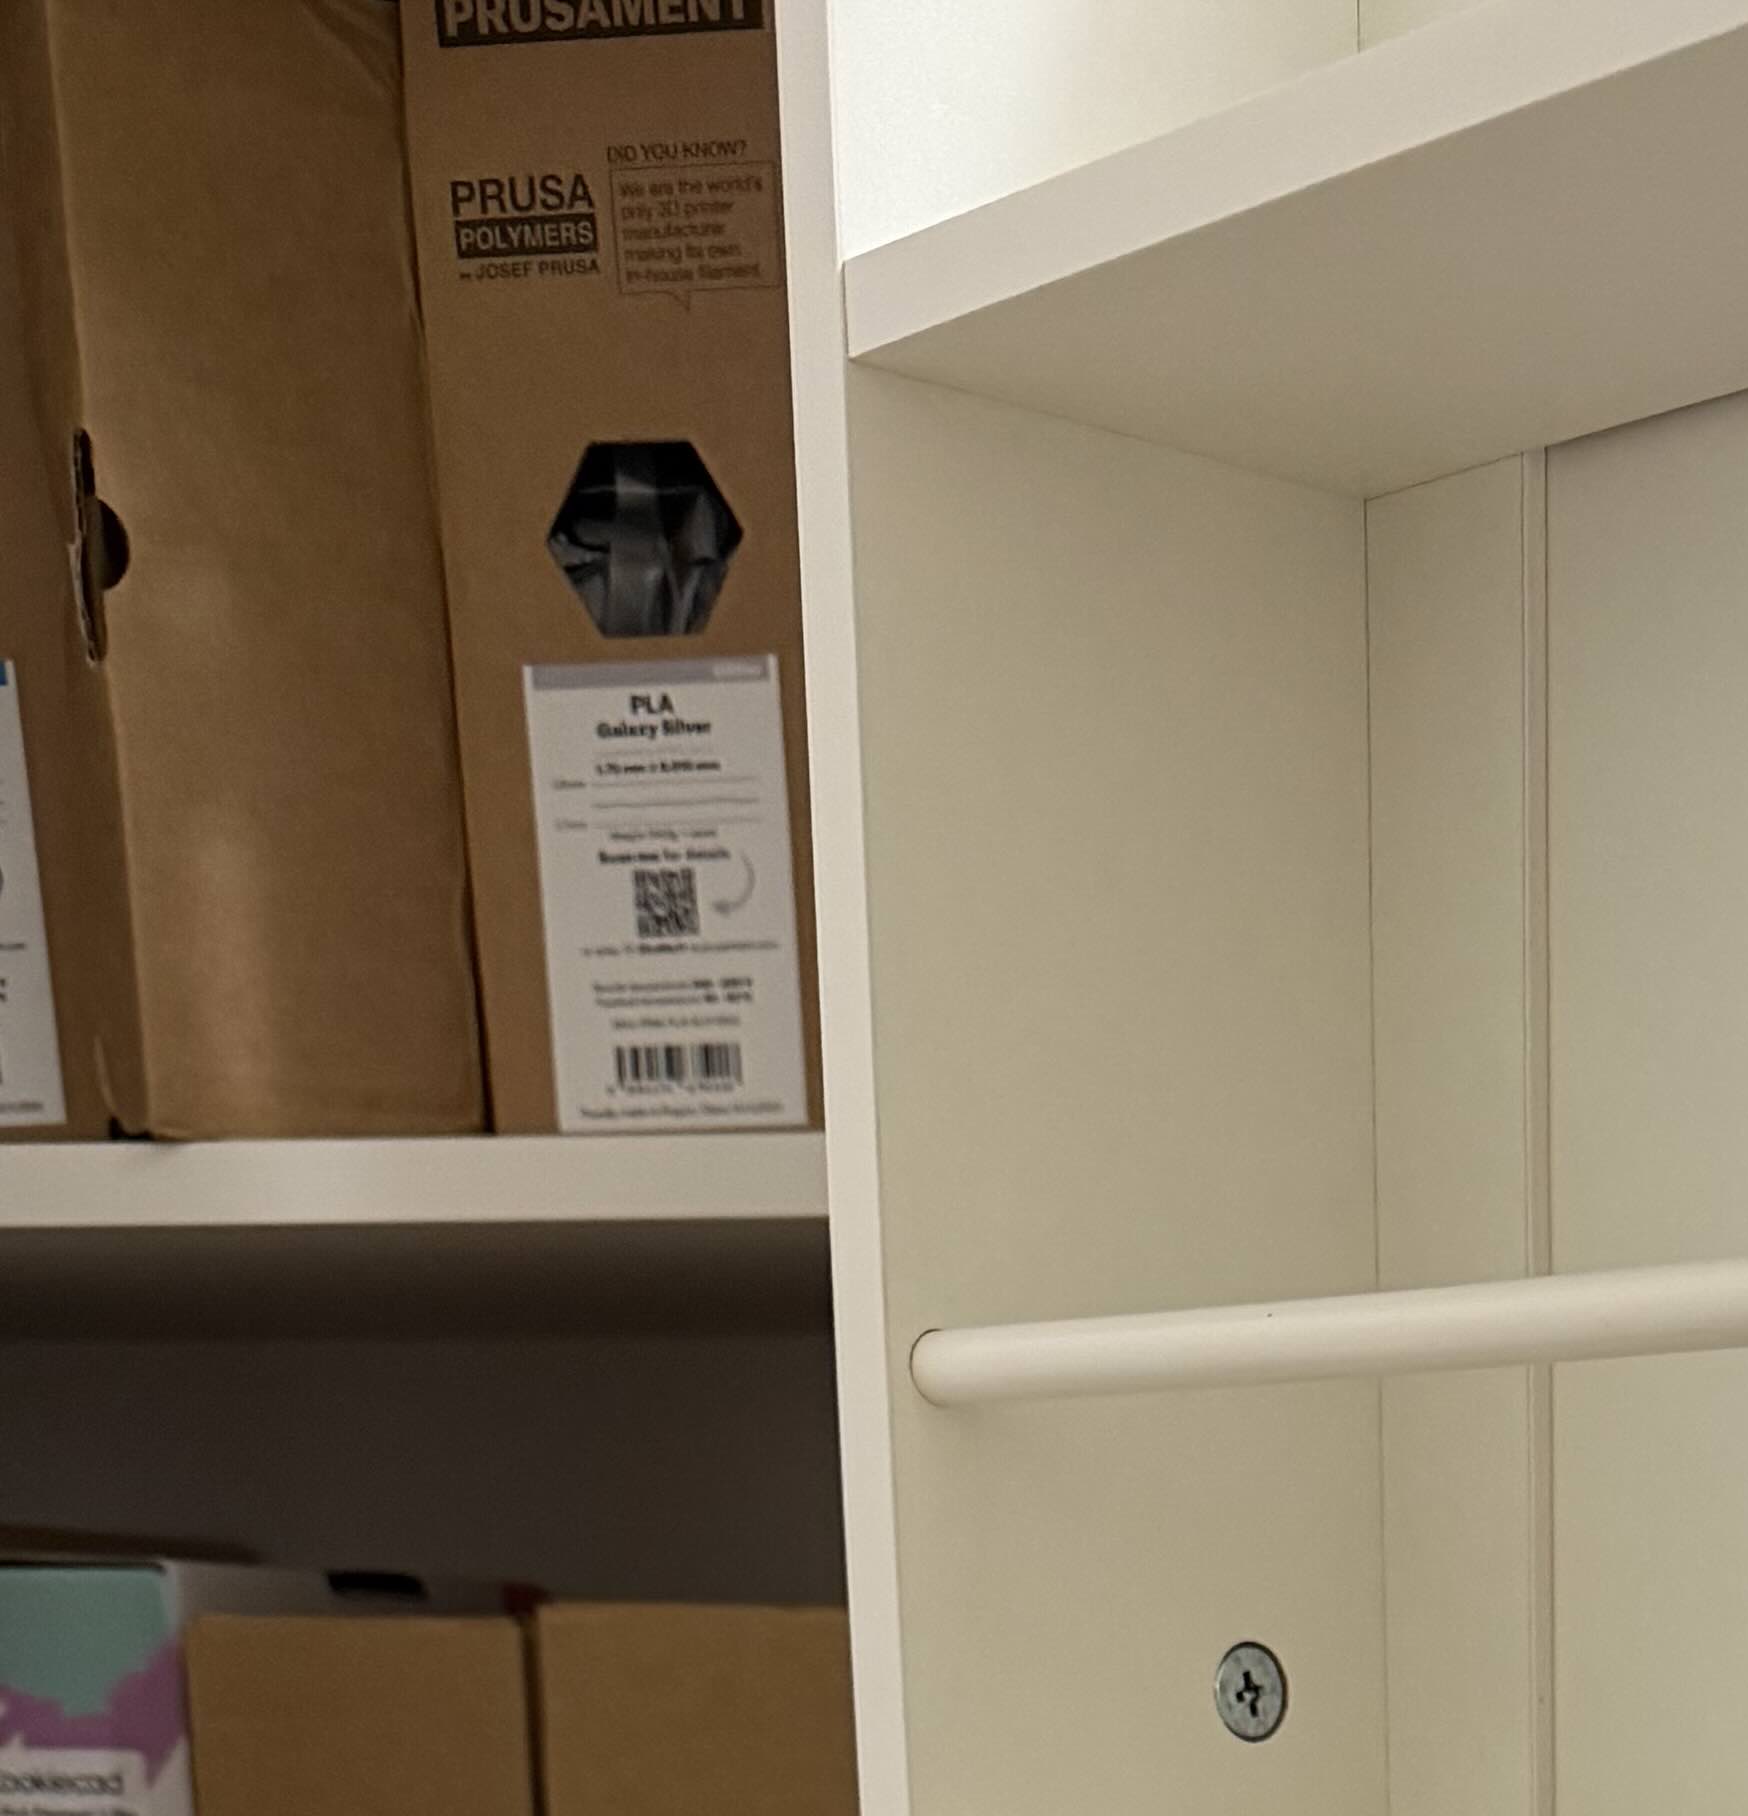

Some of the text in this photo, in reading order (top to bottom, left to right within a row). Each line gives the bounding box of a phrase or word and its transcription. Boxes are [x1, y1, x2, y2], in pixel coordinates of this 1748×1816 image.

[641, 143, 677, 161] YOU
[682, 140, 747, 159] KNOW?
[451, 174, 595, 216] PRUSA
[460, 221, 594, 252] POLYMERS
[475, 261, 532, 281] JOSEF
[539, 259, 600, 276] PRUSA
[629, 692, 674, 715] PLA
[661, 718, 712, 735] Silver
